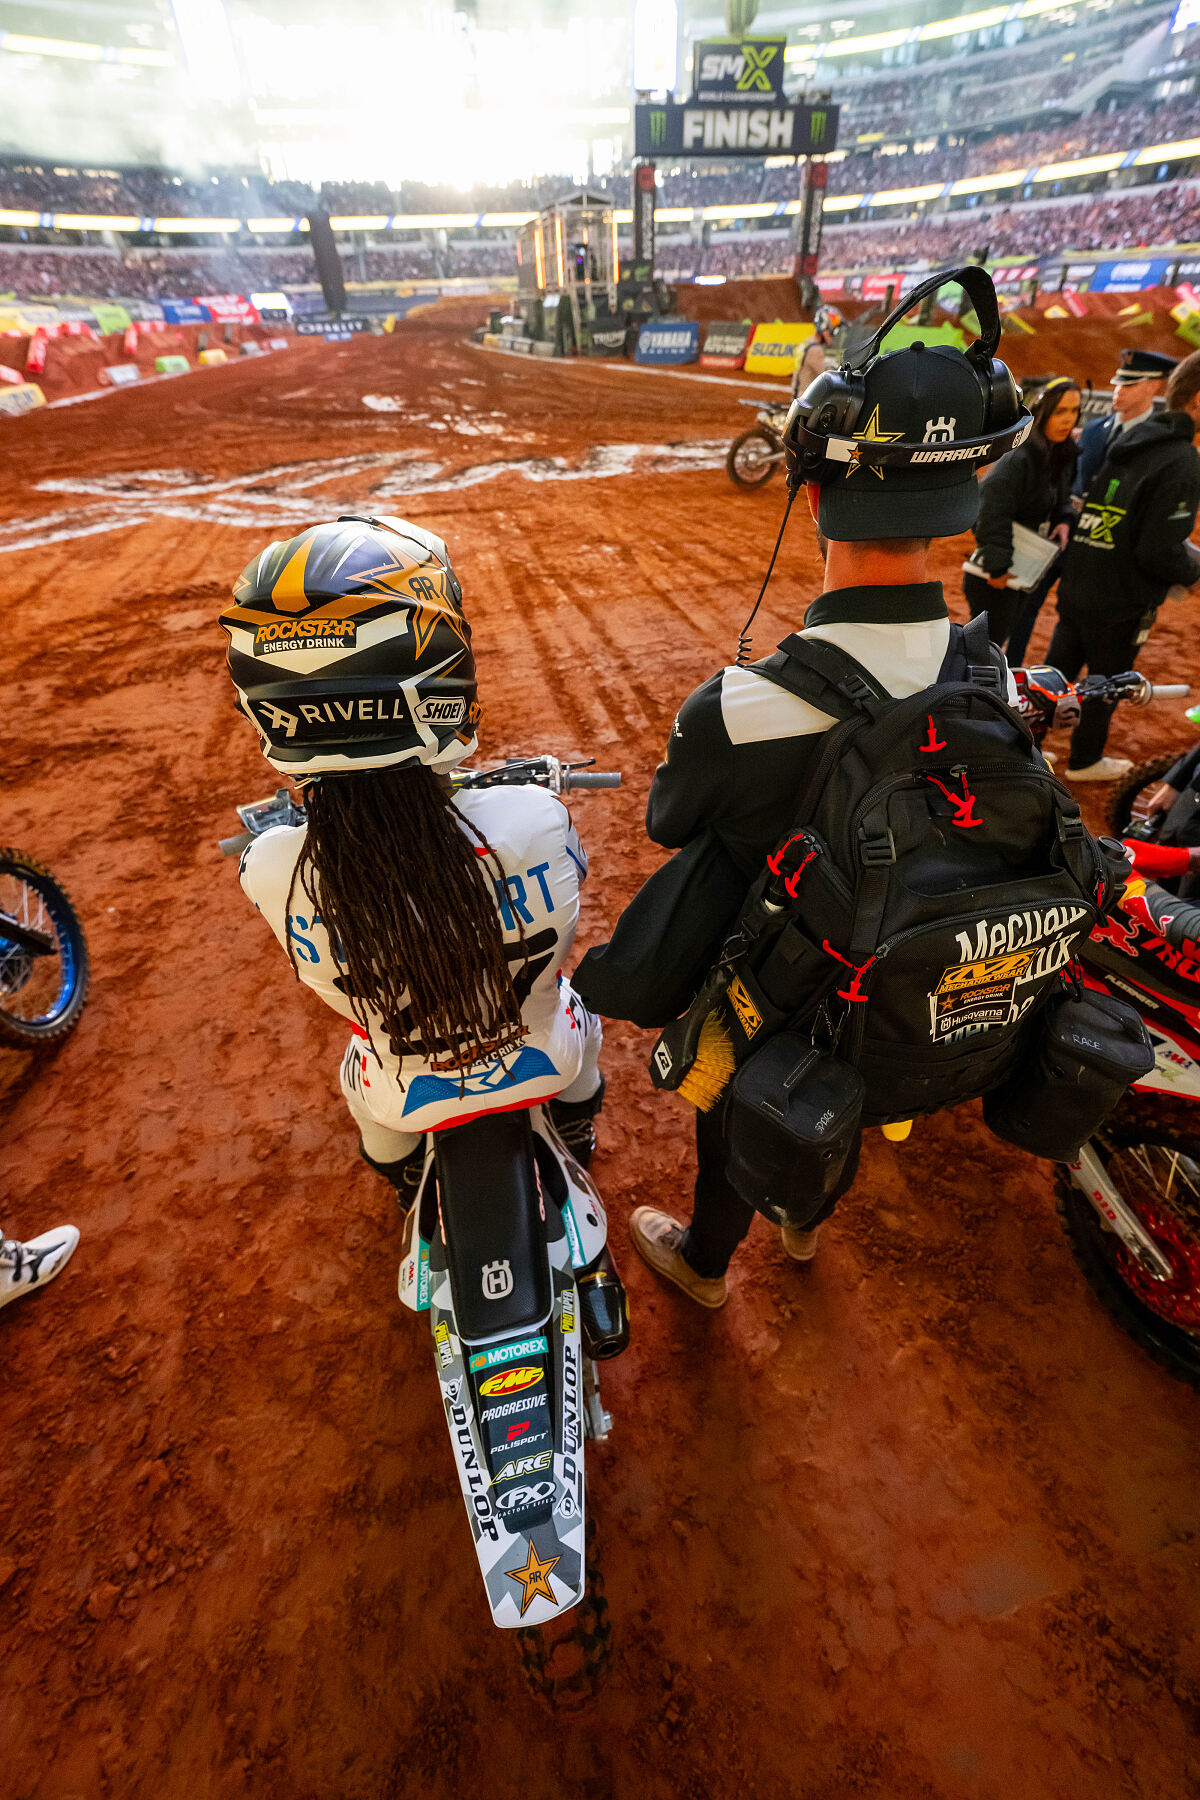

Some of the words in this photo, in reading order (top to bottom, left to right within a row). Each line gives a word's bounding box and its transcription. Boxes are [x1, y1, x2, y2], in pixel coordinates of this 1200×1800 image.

[701, 46, 778, 90] SMX
[682, 109, 795, 149] FINISH
[651, 331, 692, 348] YAMAHA
[909, 444, 991, 463] WARRICK
[255, 619, 357, 644] ROCKSTAR
[263, 638, 305, 653] ENERGY
[306, 637, 346, 648] DRINK
[298, 699, 404, 724] RIVELL
[422, 702, 463, 719] SHOEI
[993, 965, 1026, 981] WEAR
[960, 983, 1010, 1000] ROCKSTAR
[951, 1008, 1004, 1027] Husqvarna
[1071, 1033, 1101, 1050] RACE
[419, 1260, 429, 1305] MOTOREX
[487, 1338, 546, 1364] MOTOREX
[480, 1367, 543, 1396] FMF
[481, 1393, 549, 1423] PROGRESSIVE
[562, 1345, 578, 1486] DUNLOP
[490, 1432, 547, 1455] POLISPORT
[451, 1404, 500, 1542] DUNLOP
[494, 1452, 552, 1482] ARC
[497, 1504, 530, 1519] FACTORY
